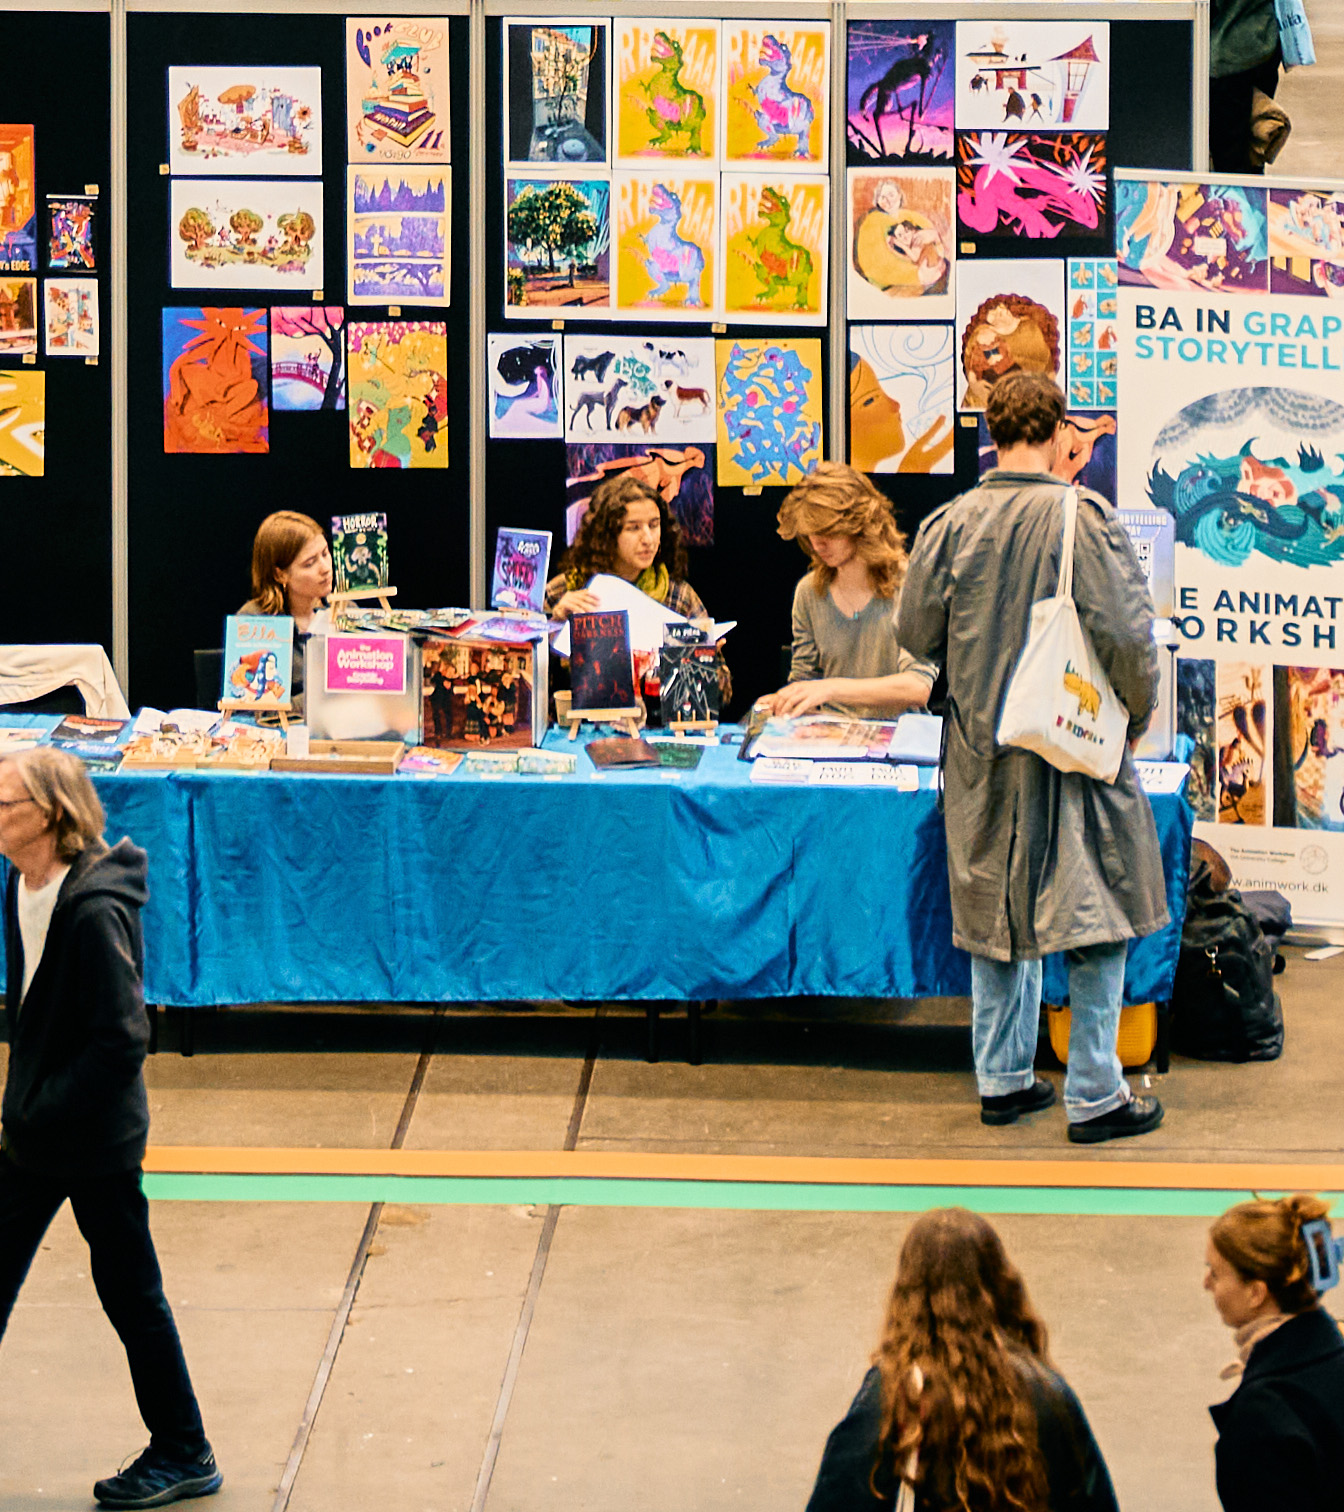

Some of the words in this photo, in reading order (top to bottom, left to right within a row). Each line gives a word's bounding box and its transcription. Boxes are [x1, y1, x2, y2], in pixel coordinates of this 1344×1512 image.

[1135, 304, 1184, 332] BA
[1196, 308, 1230, 334] IN
[1243, 311, 1343, 340] GRAP
[1135, 335, 1341, 371] STORYTELL
[342, 515, 378, 530] HORROR
[1213, 590, 1343, 619] ANIMAT
[573, 615, 623, 630] PITCH
[1180, 615, 1336, 649] ORKSH
[337, 649, 394, 661] Animation
[337, 659, 394, 672] Workshop
